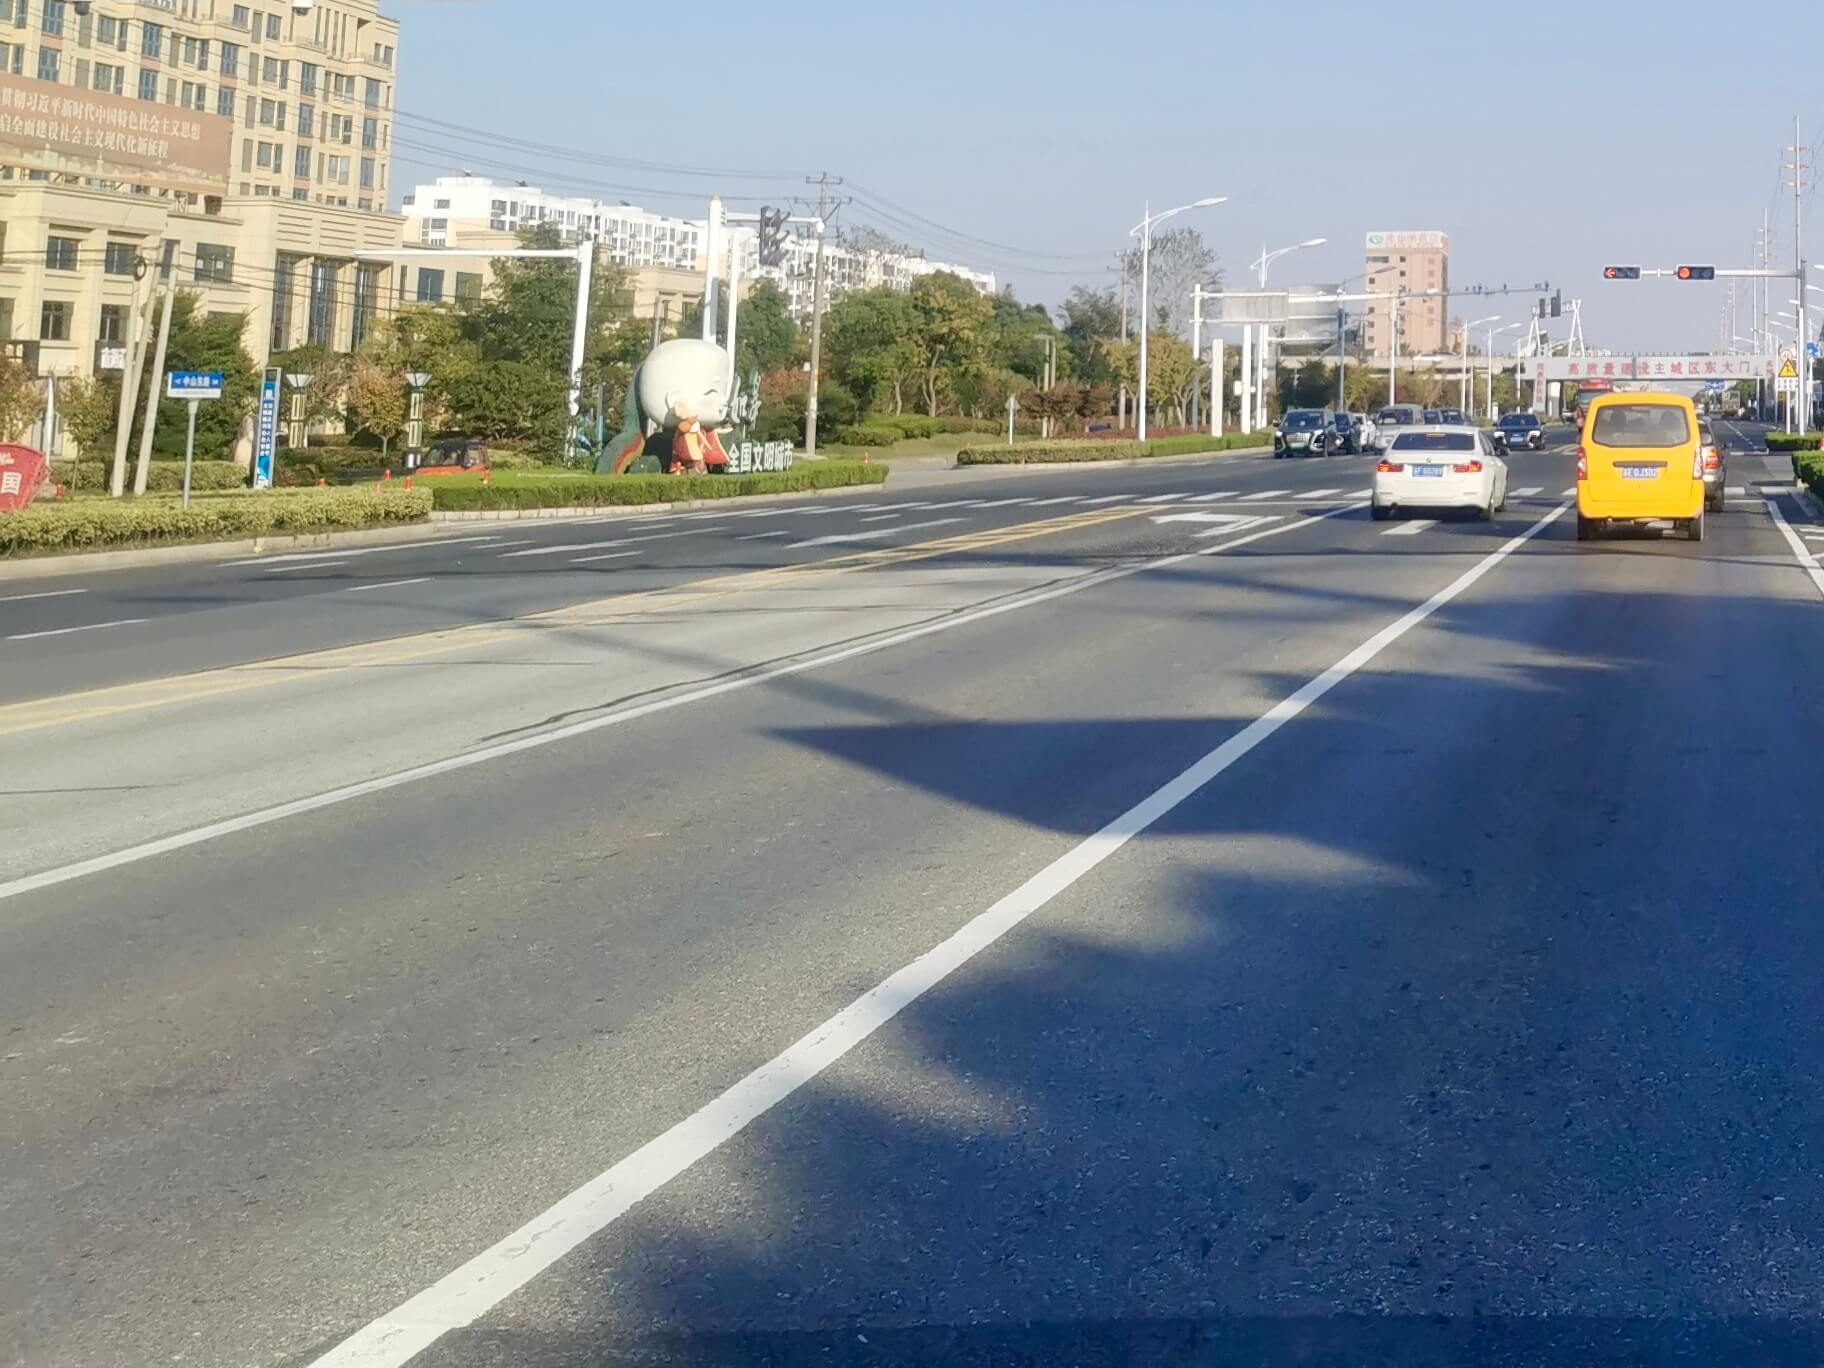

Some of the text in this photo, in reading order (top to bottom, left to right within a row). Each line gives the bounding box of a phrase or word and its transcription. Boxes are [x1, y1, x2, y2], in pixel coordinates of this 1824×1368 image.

[728, 439, 794, 474] 全国文明城市
